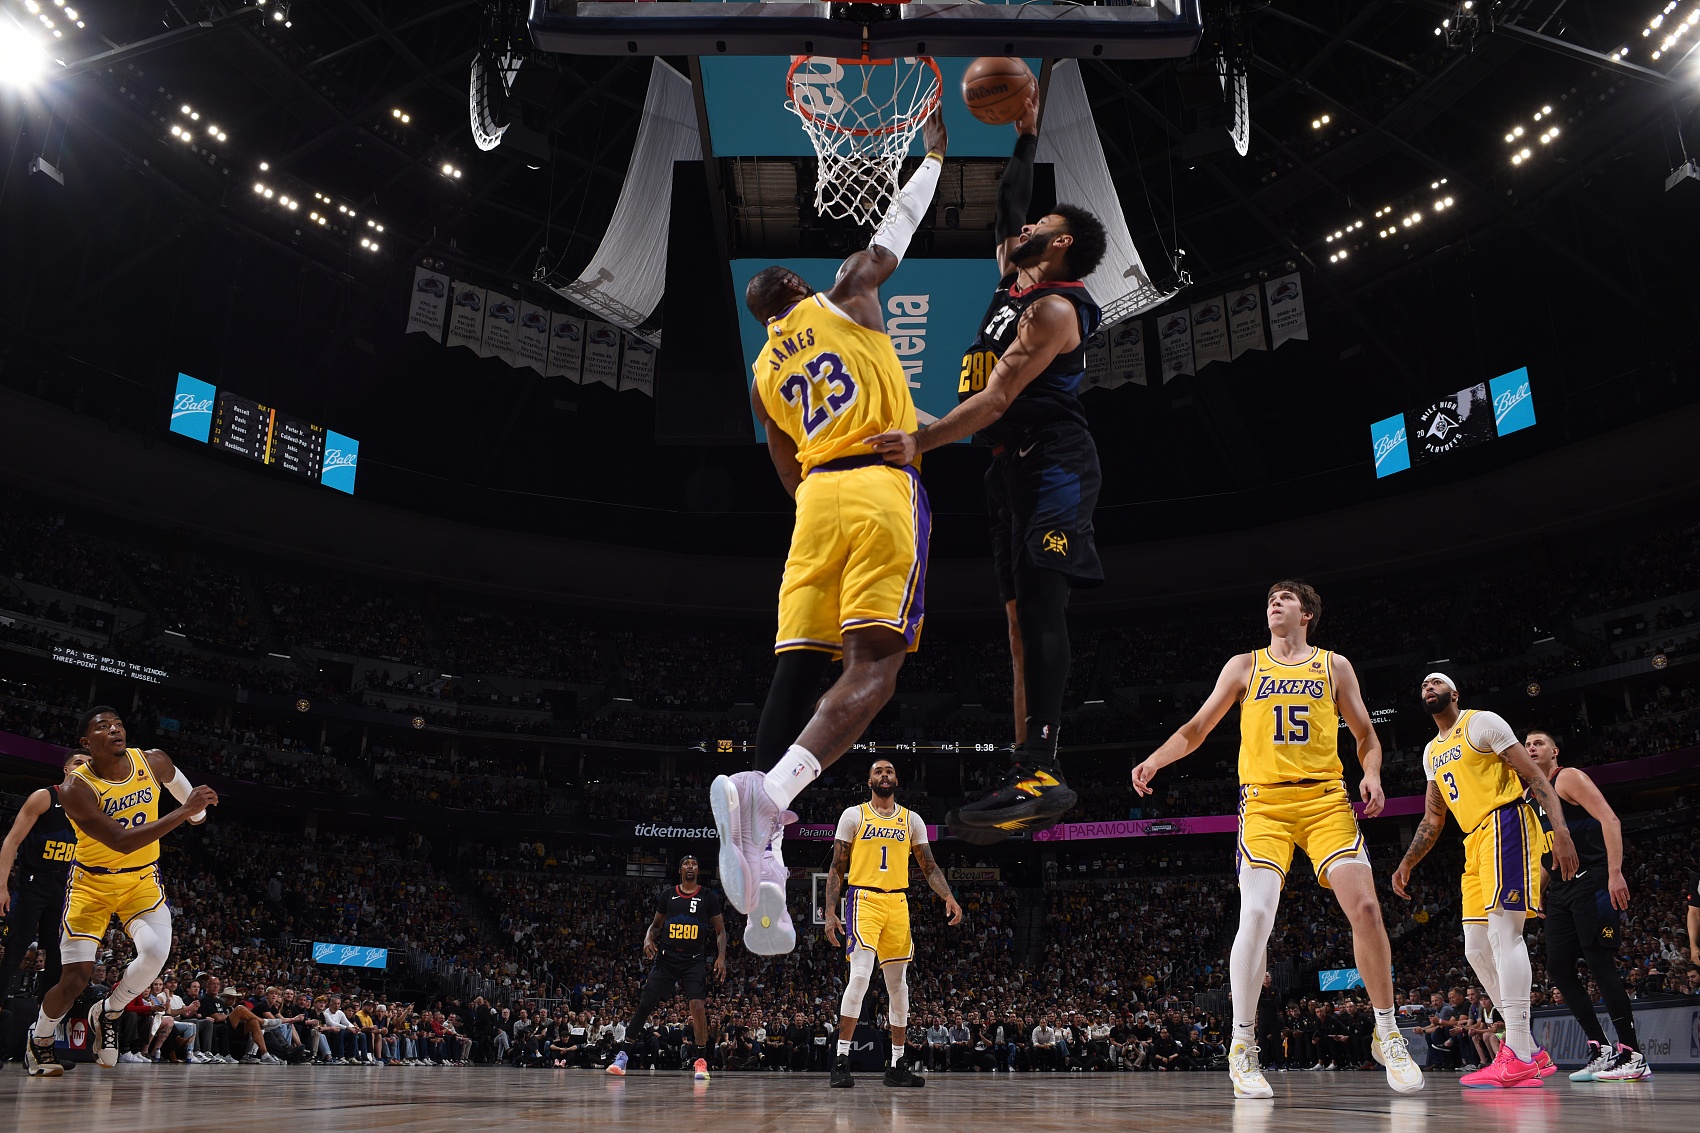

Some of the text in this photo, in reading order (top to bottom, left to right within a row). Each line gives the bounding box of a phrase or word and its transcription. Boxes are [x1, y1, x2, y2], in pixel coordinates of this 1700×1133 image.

[967, 84, 1009, 102] Wilson
[415, 311, 438, 322] DIVISION
[1276, 307, 1297, 317] 2020-21
[411, 317, 441, 330] CHAMPIONS
[457, 320, 476, 329] PACIFIC
[984, 305, 1018, 341] 27
[1277, 319, 1299, 328] TROPHY
[450, 330, 480, 342] CHAMPIONS
[454, 326, 477, 335] DIVISION
[1237, 330, 1256, 340] TROPHY
[487, 336, 511, 346] DIVISION
[517, 338, 547, 352] NORTHWEST
[1164, 342, 1189, 351] WESTERN
[1201, 340, 1221, 349] TROPHY
[484, 341, 514, 353] CHAMPIONS
[520, 346, 543, 357] DIVISION
[769, 327, 815, 371] JAMES
[1161, 347, 1191, 358] CONFERENCE
[517, 351, 546, 364] CHAMPIONS
[551, 349, 581, 360] NORTHWEST
[1162, 352, 1191, 363] CHAMPIONS
[553, 356, 576, 366] DIVISION
[585, 355, 617, 366] NORTHWEST
[589, 362, 613, 370] DIVISION
[1112, 357, 1143, 365] CONFERENCE
[549, 361, 579, 372] CHAMPIONS
[585, 367, 616, 377] CHAMPIONS
[623, 363, 653, 373] NORTHWEST
[622, 374, 653, 384] CHAMPIONS
[627, 369, 650, 378] DIVISION
[779, 351, 859, 440] 23
[1494, 381, 1531, 417] Ball
[172, 393, 213, 415] Ball
[233, 405, 250, 416] Russell
[1421, 401, 1458, 422] MILE HIGH
[234, 415, 246, 425] Davis
[231, 423, 247, 434] Reaves
[285, 424, 299, 434] Porter
[1417, 429, 1425, 439] 20
[230, 433, 245, 443] James
[1374, 427, 1407, 460] Ball
[1425, 433, 1463, 453] PLAYOFFS
[224, 440, 249, 454] Hachimura
[286, 444, 298, 453] Jokic
[284, 452, 299, 463] Murray
[323, 448, 357, 468] Ball
[283, 461, 298, 472] Gordon
[52, 653, 98, 669] THREE-POINT
[131, 672, 162, 684] RUSSELL.
[66, 648, 79, 657] PA:
[101, 656, 114, 665] MPJ
[117, 659, 126, 668] TO
[129, 662, 141, 671] THE
[143, 666, 170, 678] WINDOW.
[1254, 676, 1324, 701] LAKERS
[1372, 708, 1398, 716] WINDOW.
[1272, 704, 1311, 745] 15
[1370, 716, 1391, 724] SSELL.
[974, 743, 994, 752] 9:38
[1432, 745, 1462, 775] LAKERS
[1443, 771, 1460, 803] 3
[103, 786, 153, 817] LAKERS
[799, 827, 836, 837] Paramo
[860, 823, 906, 842] LAKERS
[880, 845, 888, 873] 1
[952, 867, 982, 880] Coors
[689, 900, 698, 914] 5
[668, 923, 699, 940] 5280
[315, 943, 385, 963] Ball Ball Ball
[1321, 969, 1361, 986] Ball Ba
[73, 1030, 85, 1039] TNT
[1648, 1038, 1672, 1056] Pixel
